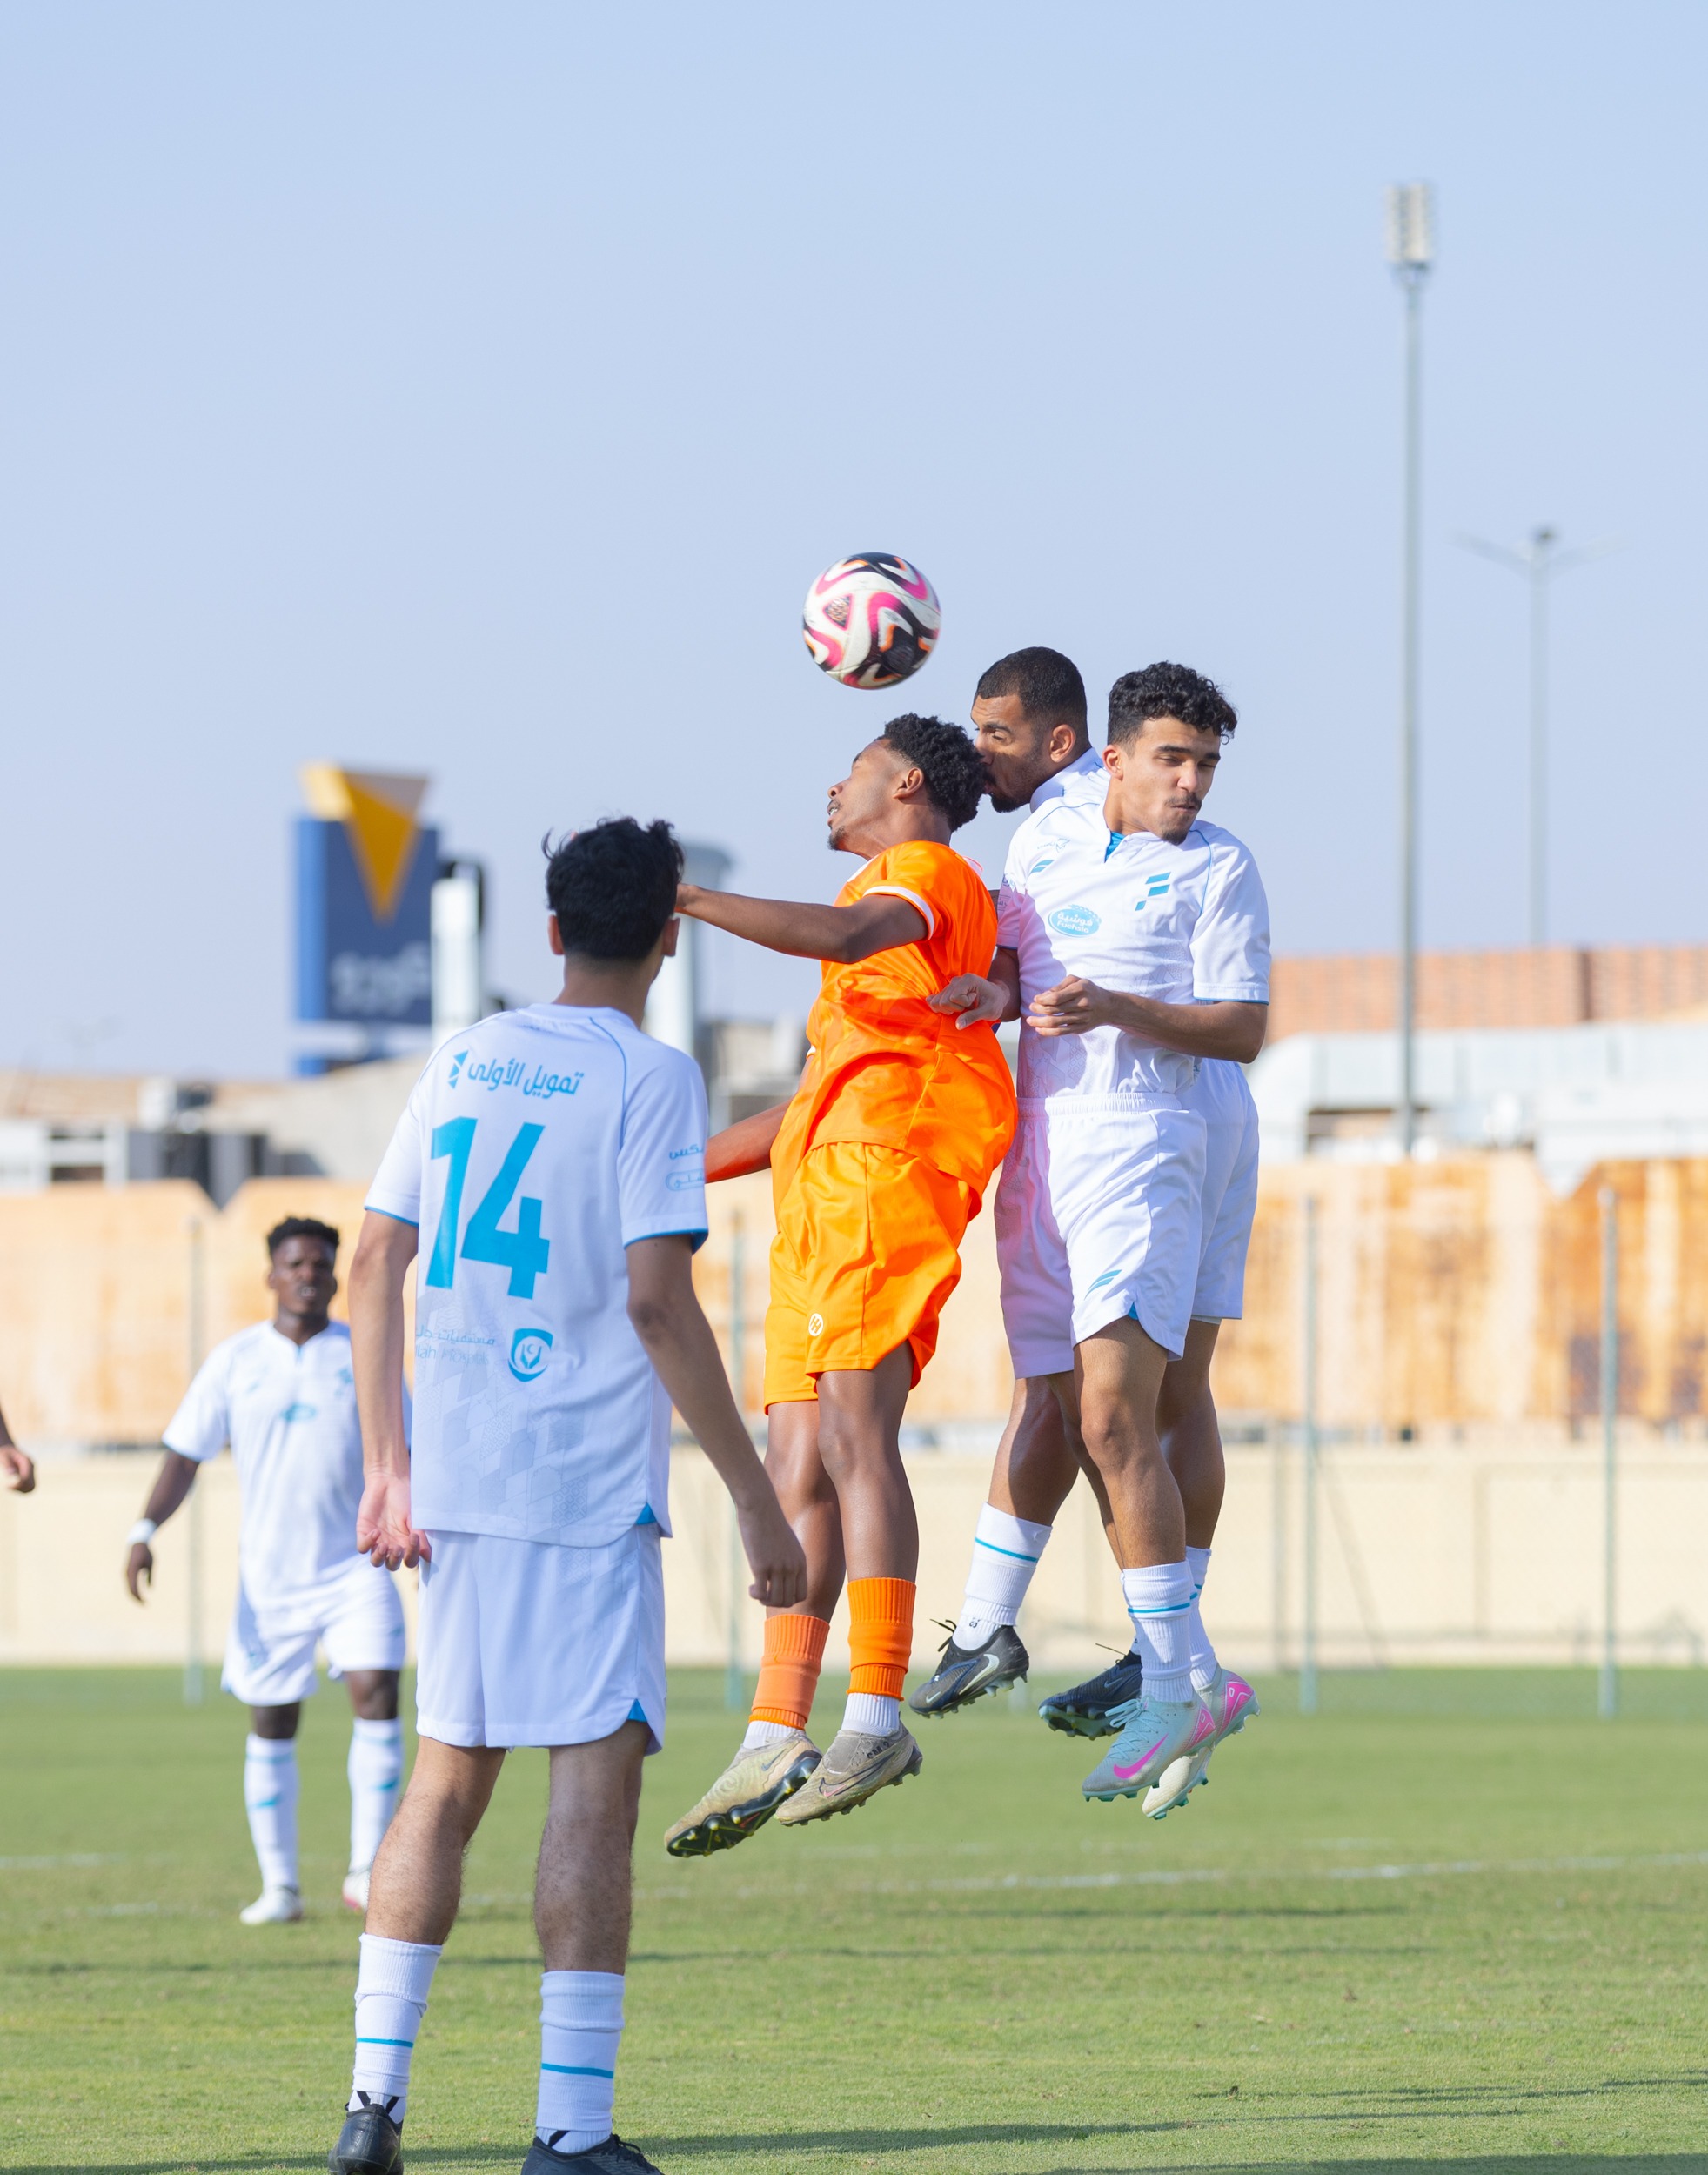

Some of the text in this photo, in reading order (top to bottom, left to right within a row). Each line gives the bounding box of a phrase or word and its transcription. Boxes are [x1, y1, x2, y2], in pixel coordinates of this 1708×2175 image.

[467, 1057, 585, 1099] تمويل الأولى
[425, 1115, 550, 1300] 14
[438, 1329, 495, 1345] مستشفيات
